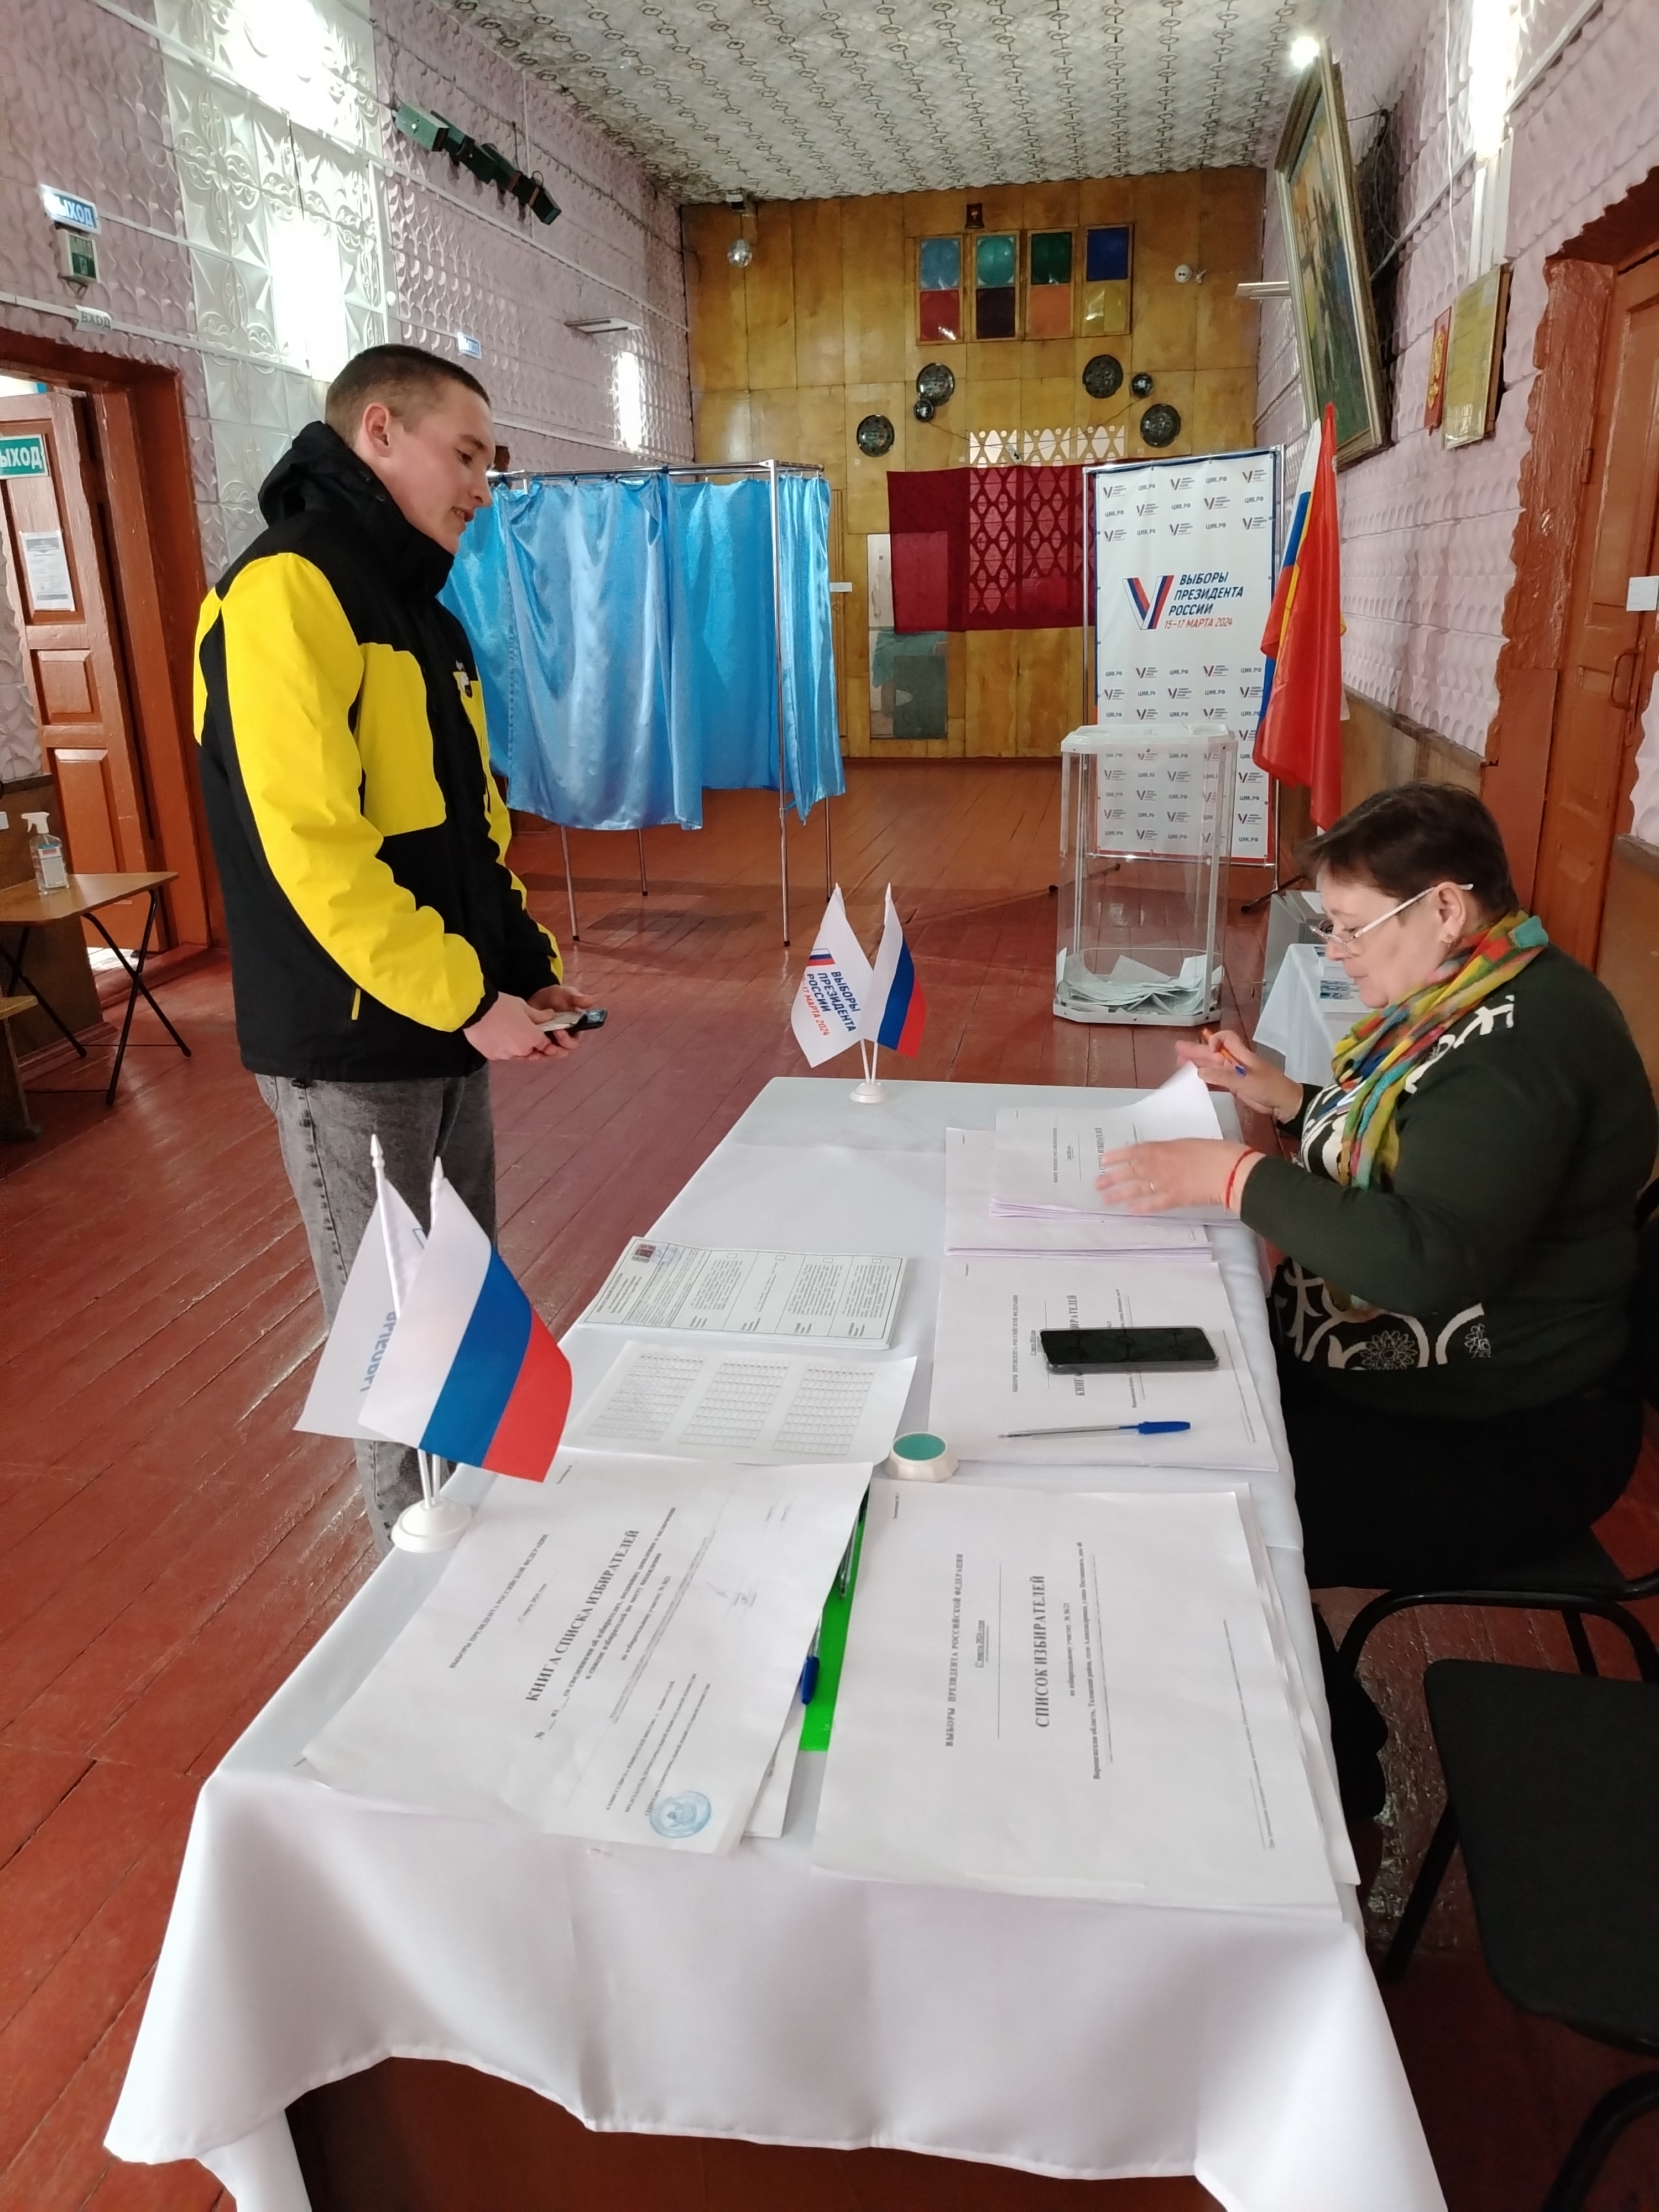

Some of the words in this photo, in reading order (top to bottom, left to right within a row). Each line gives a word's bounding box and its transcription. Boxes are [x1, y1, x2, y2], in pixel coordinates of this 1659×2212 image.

[81, 310, 111, 330] ВХОД
[0, 446, 43, 469] ЫХОД
[1174, 586, 1244, 601] ПРЕЗИДЕНТА
[1180, 572, 1229, 585] ВЫБОРЫ
[1168, 603, 1213, 616] РОССИИ
[1186, 618, 1213, 628] МАРТА
[1215, 617, 1233, 627] 2024
[807, 974, 831, 1011] РОССИИ
[817, 973, 857, 1031] ПРЕЗИДЕНТА
[831, 972, 861, 1011] ВЫБОРЫ
[805, 995, 821, 1018] МАРТА
[816, 1020, 830, 1035] 2024
[525, 1657, 561, 1700] КНИГА
[555, 1609, 593, 1653] СПИСКА
[586, 1531, 639, 1604] ИЗБИРАТЕЛЕЙ
[1030, 1576, 1047, 1665] ИЗБИРАТЕЛЕЙ
[1035, 1668, 1049, 1727] СПИСОК
